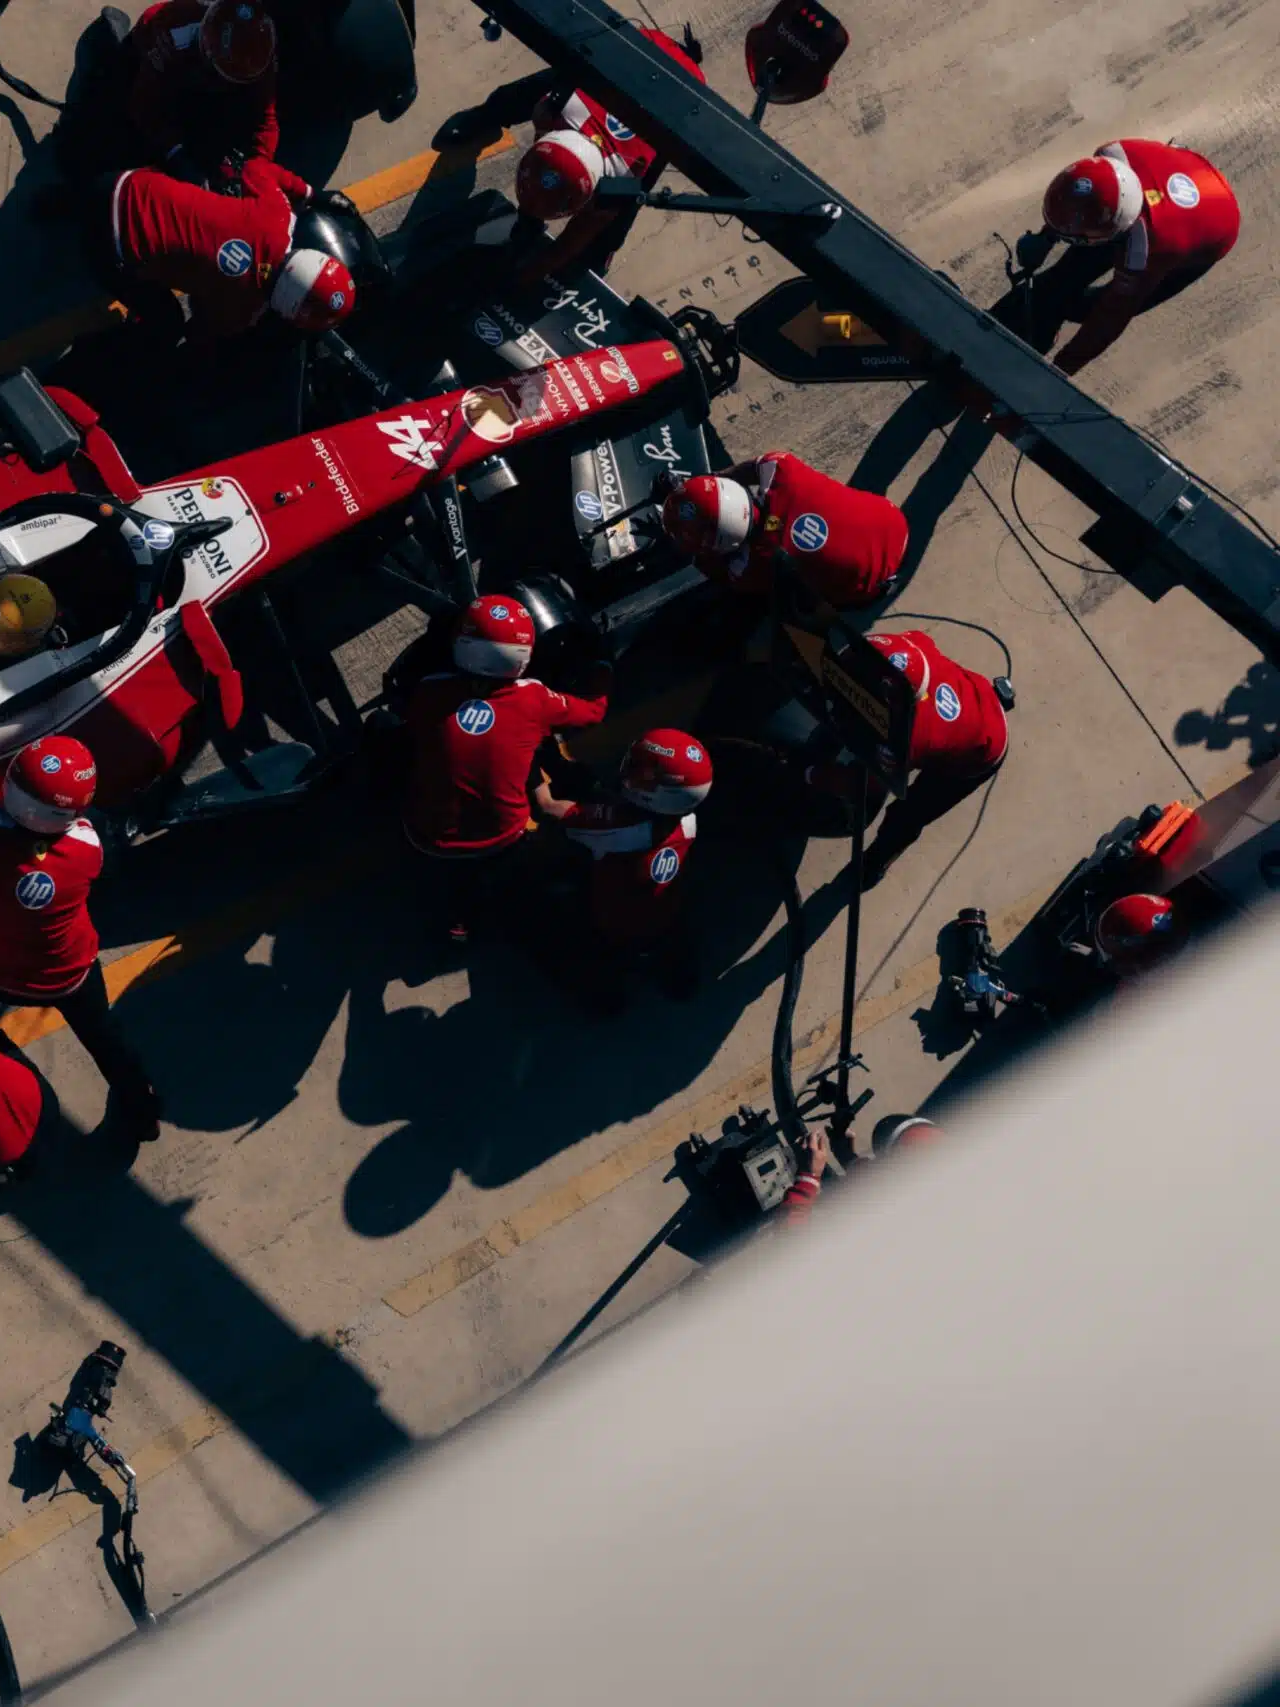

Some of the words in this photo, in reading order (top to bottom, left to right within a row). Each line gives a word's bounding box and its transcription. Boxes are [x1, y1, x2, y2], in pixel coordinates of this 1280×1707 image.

[219, 239, 251, 275] hp
[543, 273, 611, 350] Ray-Ban
[492, 303, 547, 365] V-Powe
[375, 415, 444, 471] 44
[643, 424, 692, 476] y-Ban
[311, 437, 360, 515] Bitdefender
[20, 516, 58, 533] ambipar
[444, 497, 462, 545] vantage
[576, 492, 604, 520] hp
[167, 496, 184, 520] NASTR
[198, 550, 216, 580] ZZURRO
[791, 514, 829, 551] hp
[490, 605, 509, 620] hp
[456, 699, 495, 735] hp
[936, 684, 961, 721] hp
[651, 848, 680, 883] hp
[17, 871, 55, 910] hp
